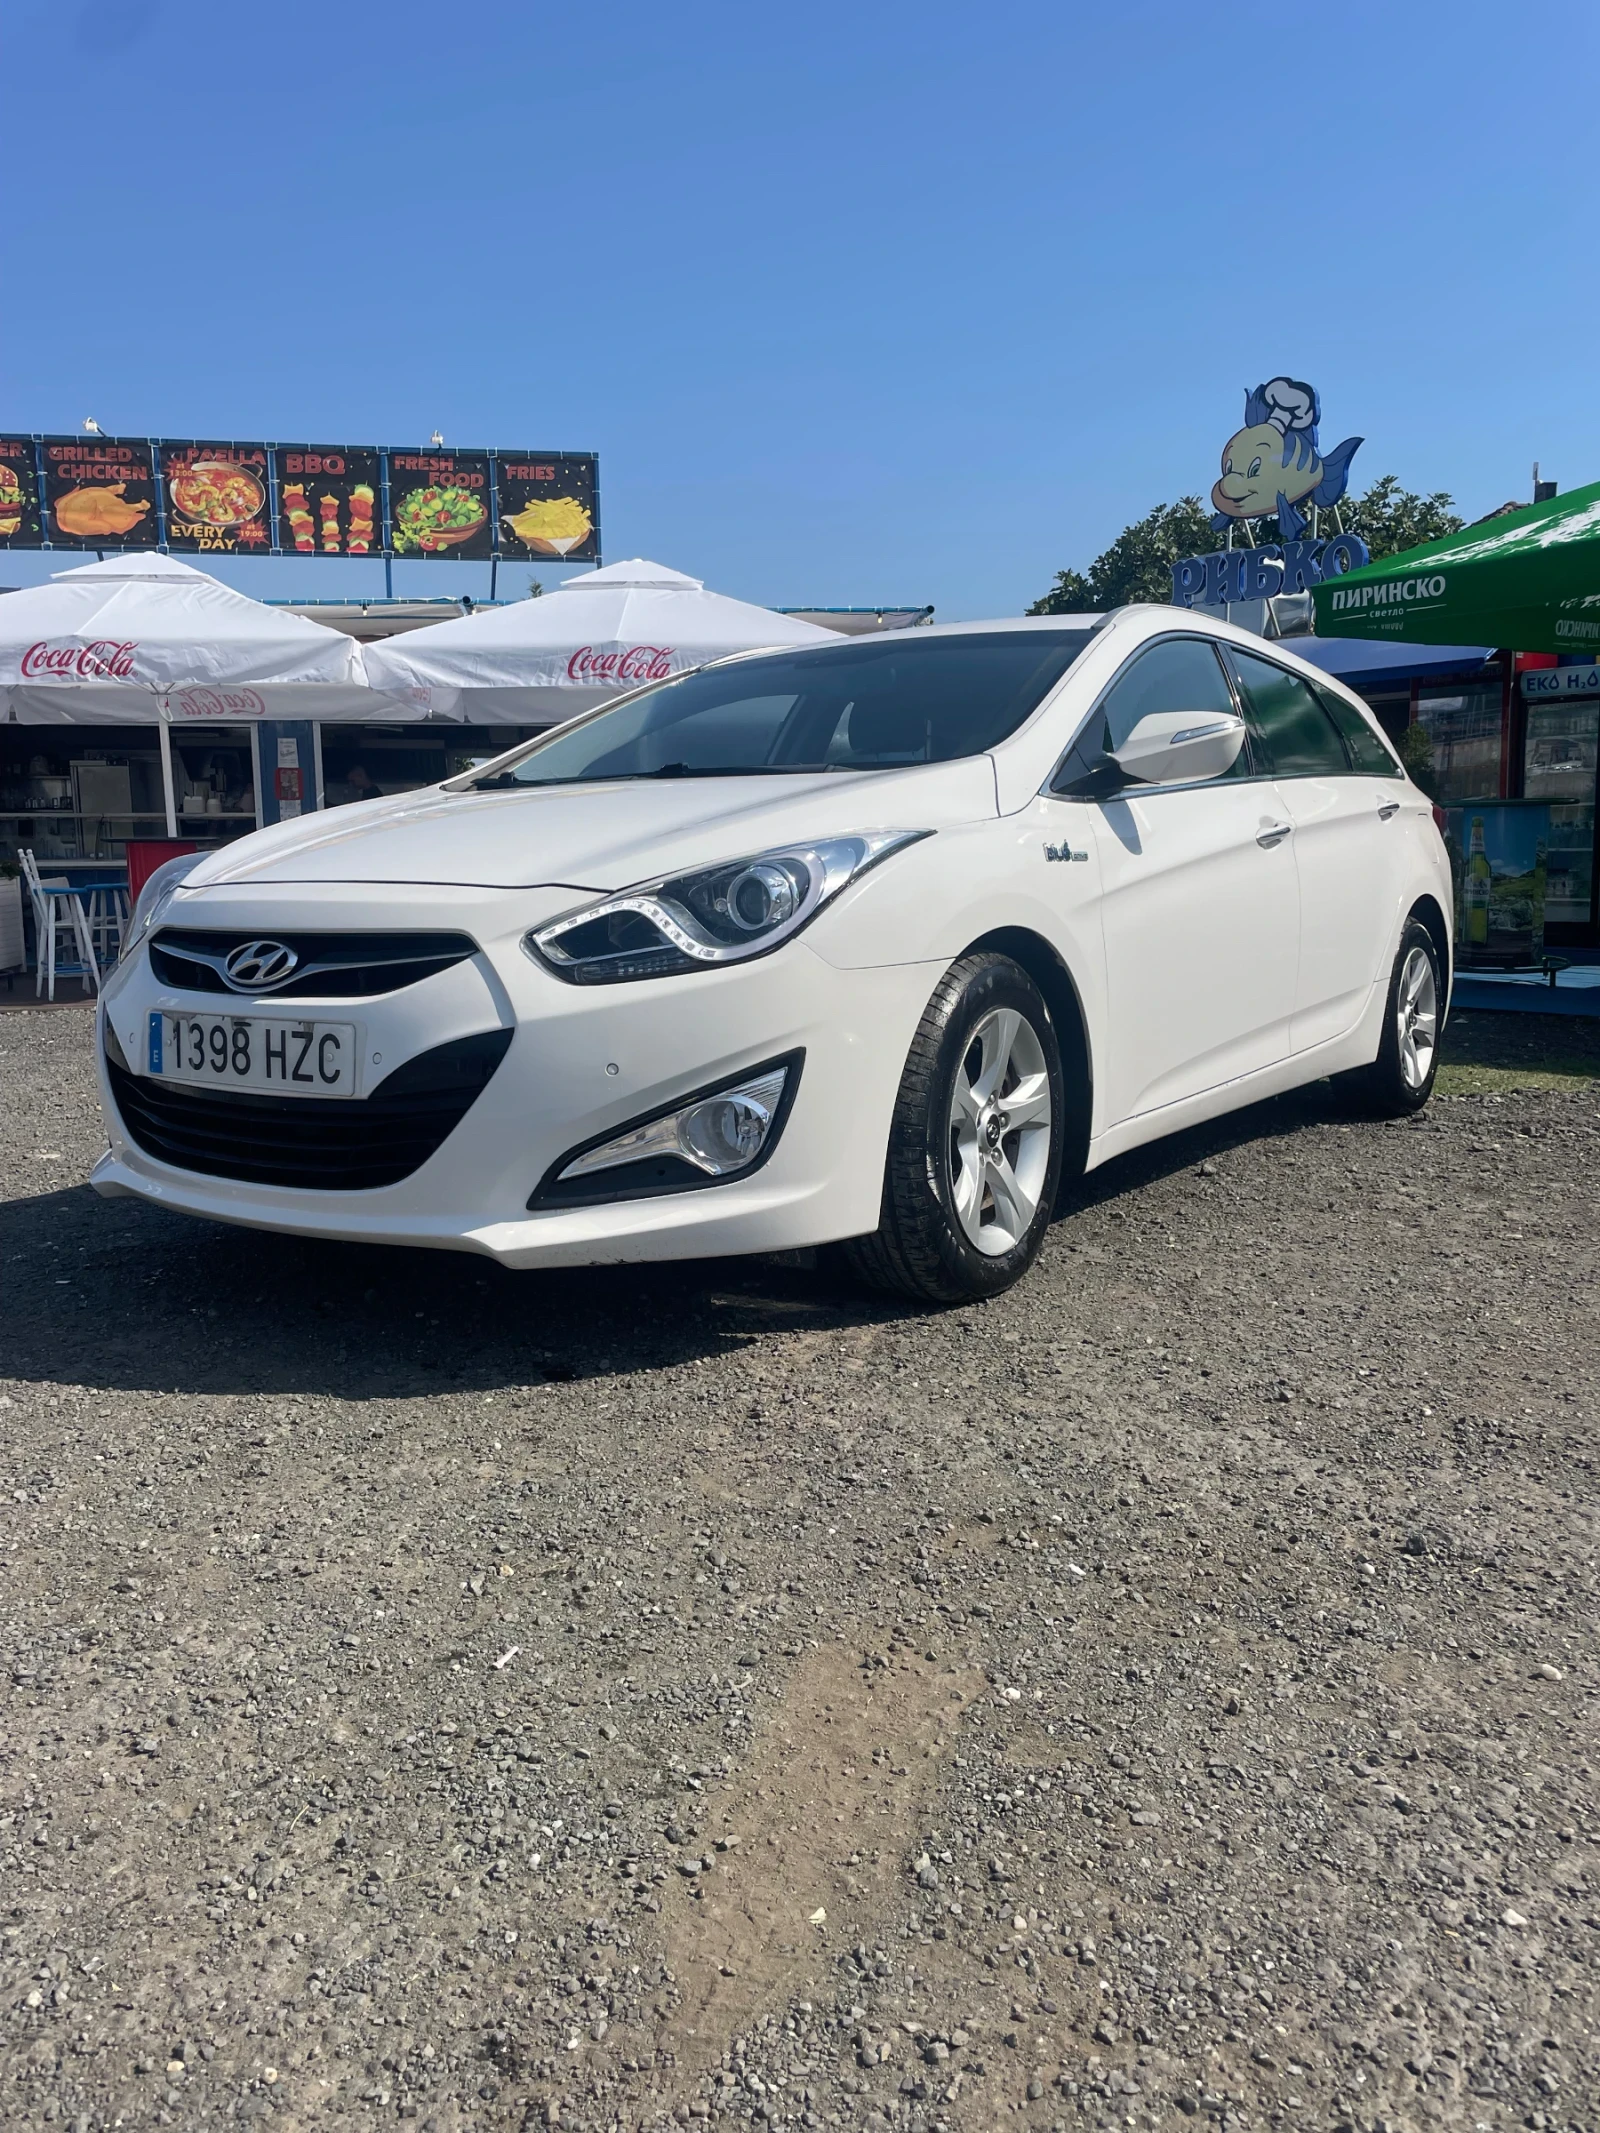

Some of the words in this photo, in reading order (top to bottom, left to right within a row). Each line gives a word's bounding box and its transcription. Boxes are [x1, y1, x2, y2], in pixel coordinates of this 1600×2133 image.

[48, 446, 132, 462] GRILLED
[186, 447, 266, 465] PAELLA
[286, 454, 345, 475] BBQ
[394, 456, 453, 471] FRESH
[57, 464, 148, 480] CHICKEN
[170, 469, 193, 477] 13:00
[429, 472, 484, 487] FOOD
[507, 465, 555, 480] FRIES
[171, 525, 226, 538] EVERY
[200, 538, 236, 550] DAY
[1170, 533, 1369, 609] РИБКО
[1332, 575, 1446, 611] ПИРИНСКО
[1369, 607, 1404, 618] светло
[153, 1050, 159, 1062] E
[173, 1021, 251, 1076] 1398
[265, 1028, 341, 1084] HZC
